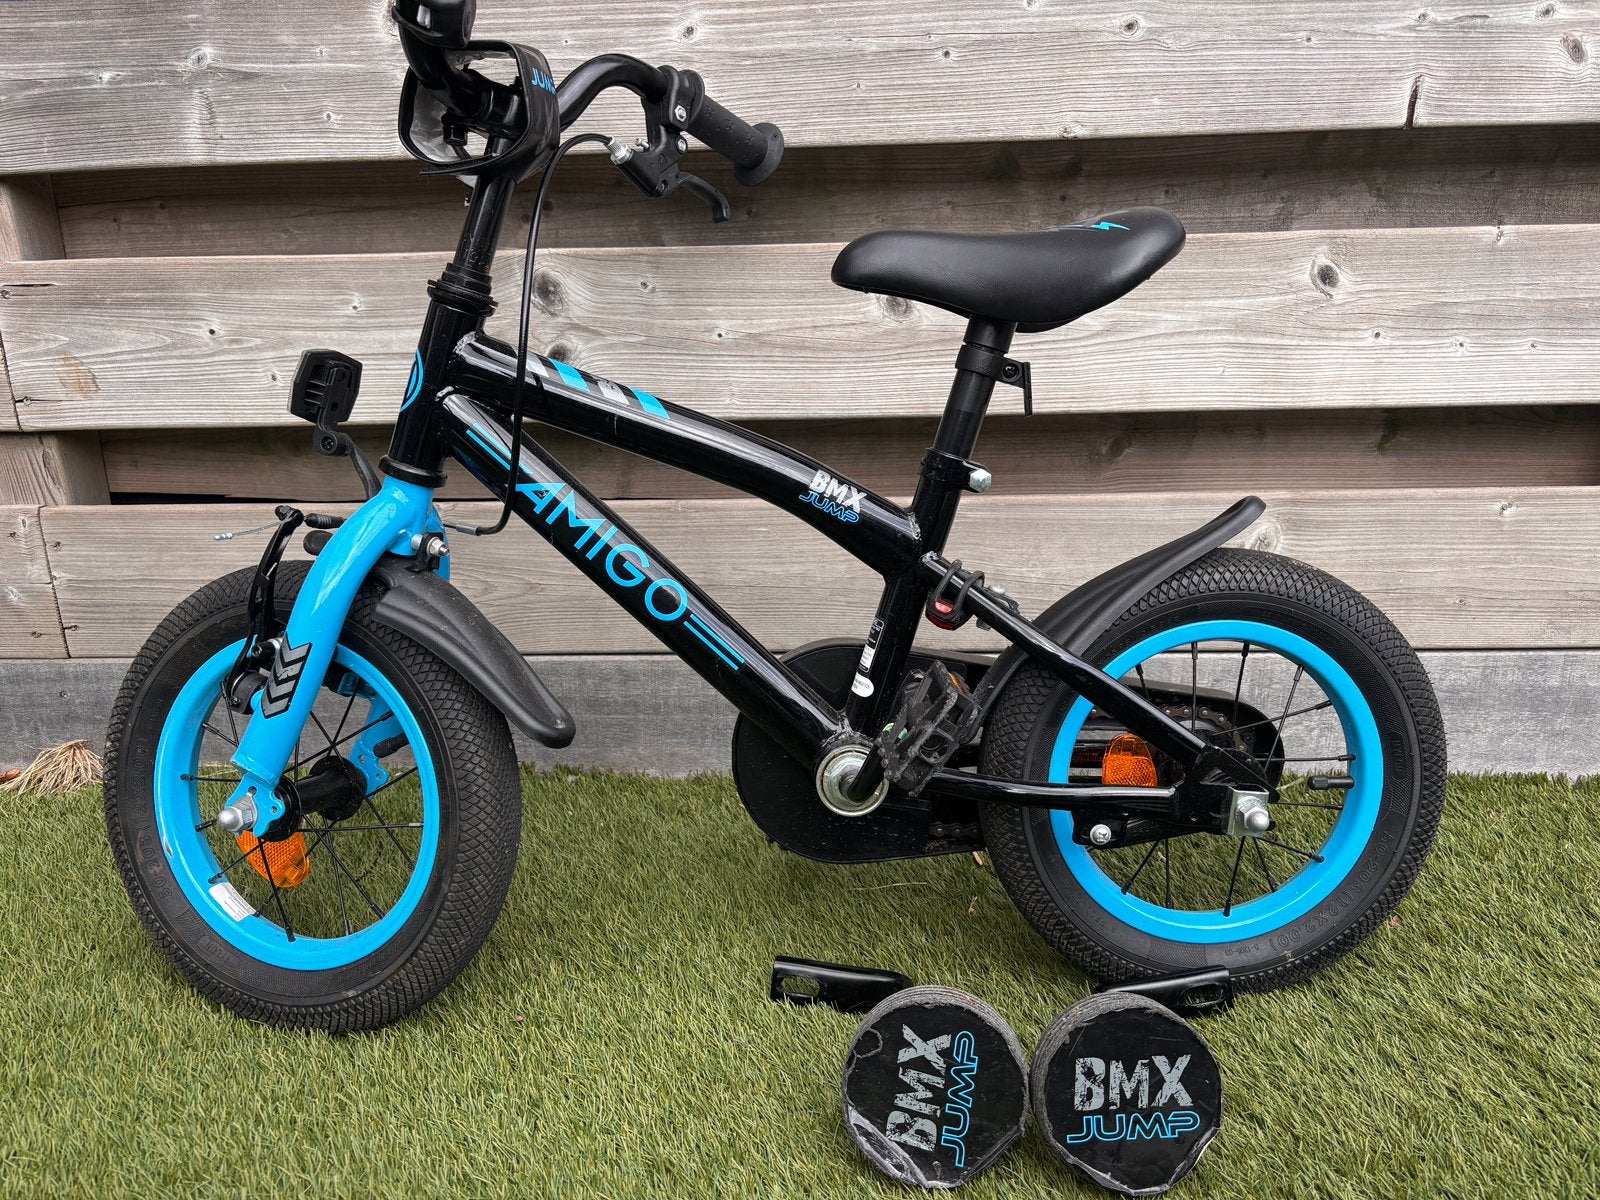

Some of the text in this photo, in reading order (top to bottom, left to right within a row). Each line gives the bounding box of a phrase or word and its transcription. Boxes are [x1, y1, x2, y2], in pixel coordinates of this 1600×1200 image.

[798, 491, 860, 523] JUMP
[809, 469, 868, 514] BMX
[507, 481, 690, 622] AMIGO
[885, 1023, 952, 1152] BMX
[940, 1030, 979, 1168] JUMP
[1073, 1053, 1194, 1112] BMX
[1066, 1110, 1201, 1144] JUMP
